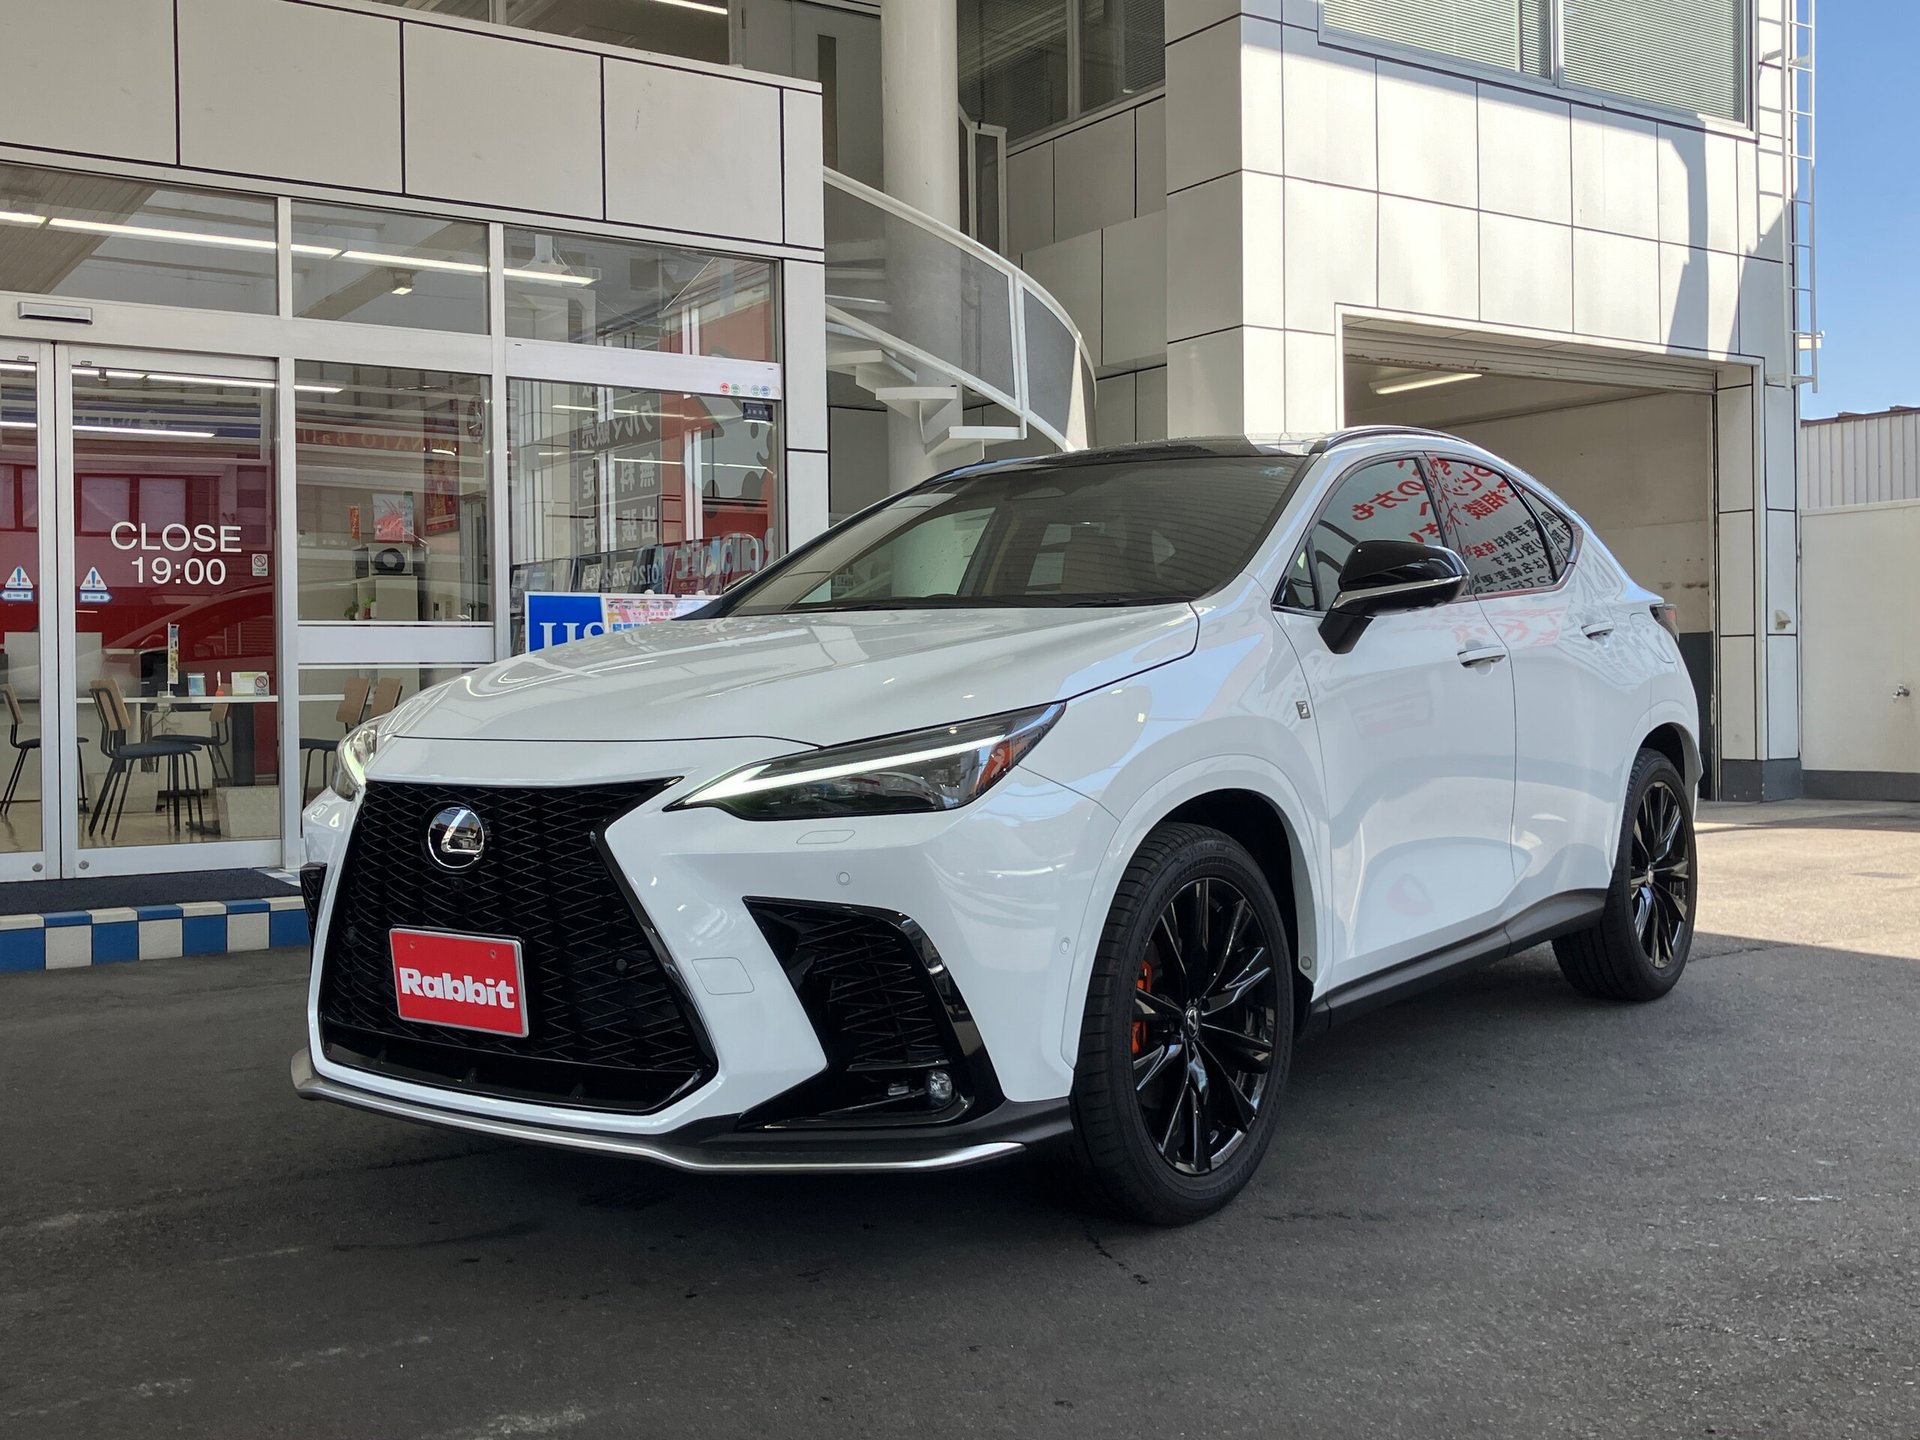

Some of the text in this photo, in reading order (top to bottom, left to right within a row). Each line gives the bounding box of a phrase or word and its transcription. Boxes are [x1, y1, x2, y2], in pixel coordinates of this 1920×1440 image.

[110, 521, 242, 553] CLOSE
[131, 556, 228, 586] 19:00
[399, 967, 515, 1009] Rabbit
